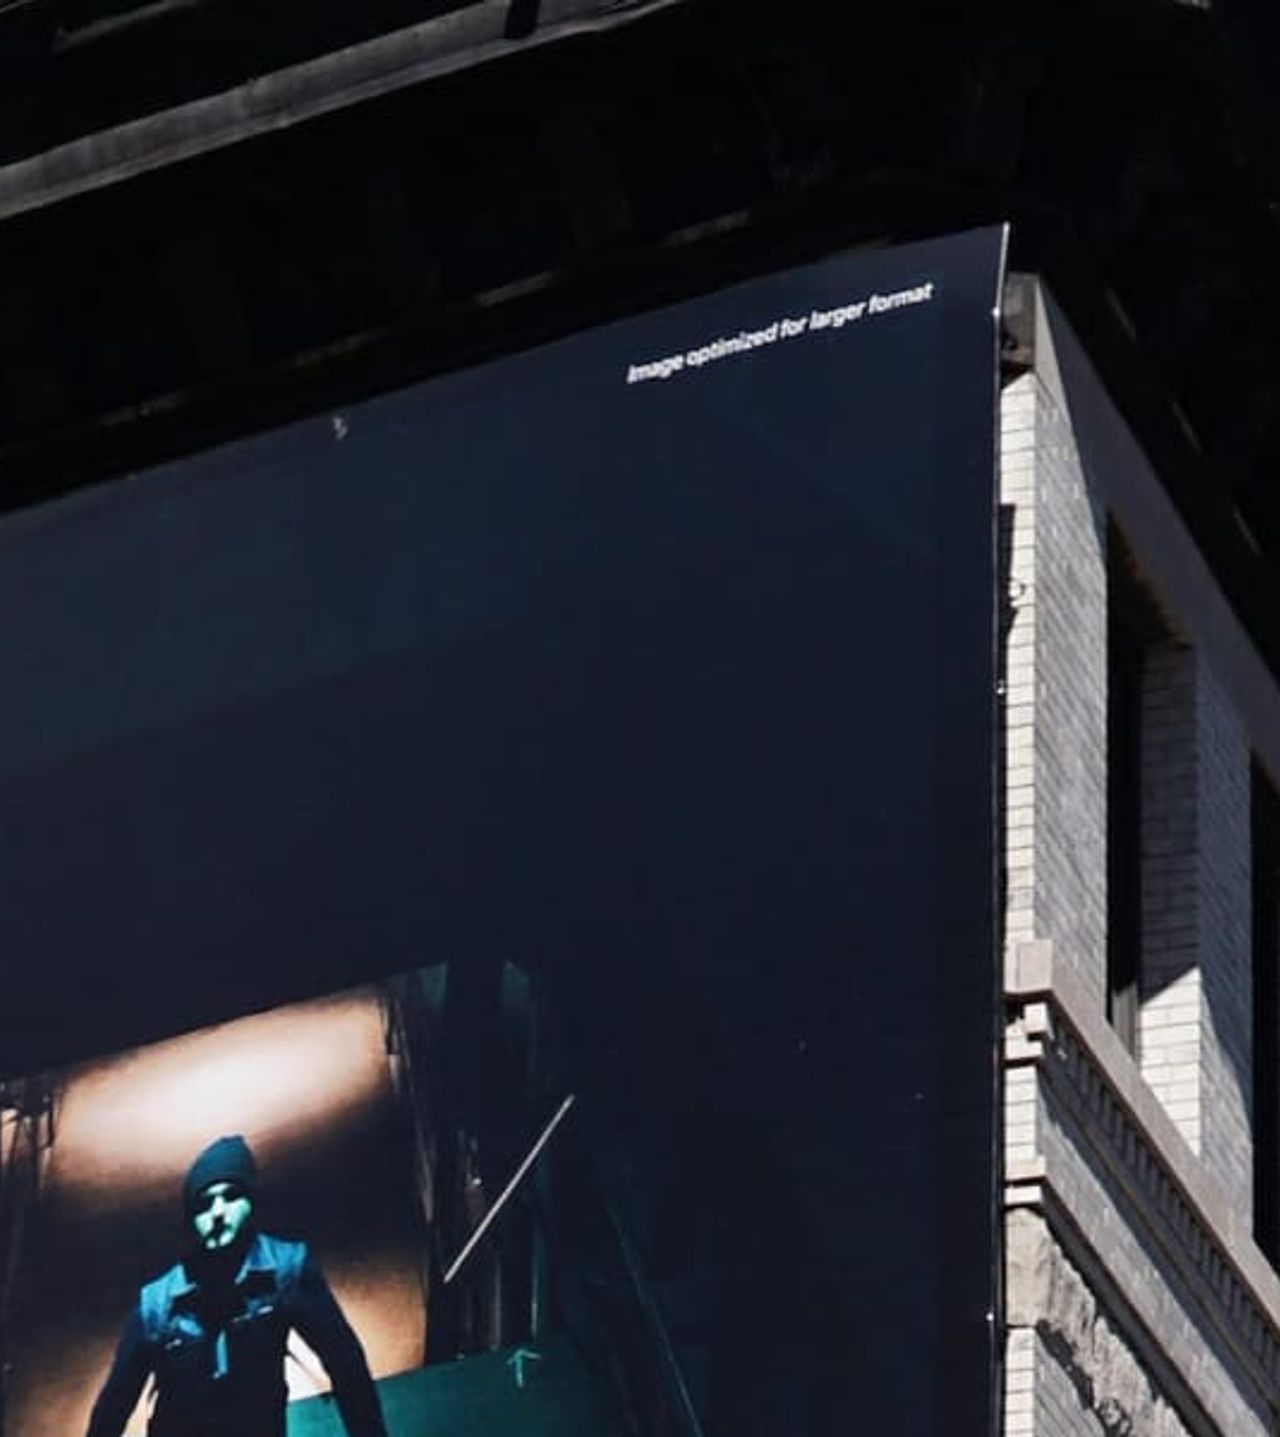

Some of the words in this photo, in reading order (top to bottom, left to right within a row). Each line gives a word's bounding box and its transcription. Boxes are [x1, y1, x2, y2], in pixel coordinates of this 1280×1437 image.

[627, 355, 684, 384] Image
[686, 323, 777, 367] optimized
[779, 314, 807, 340] for
[809, 300, 866, 330] larger
[868, 282, 934, 314] format
